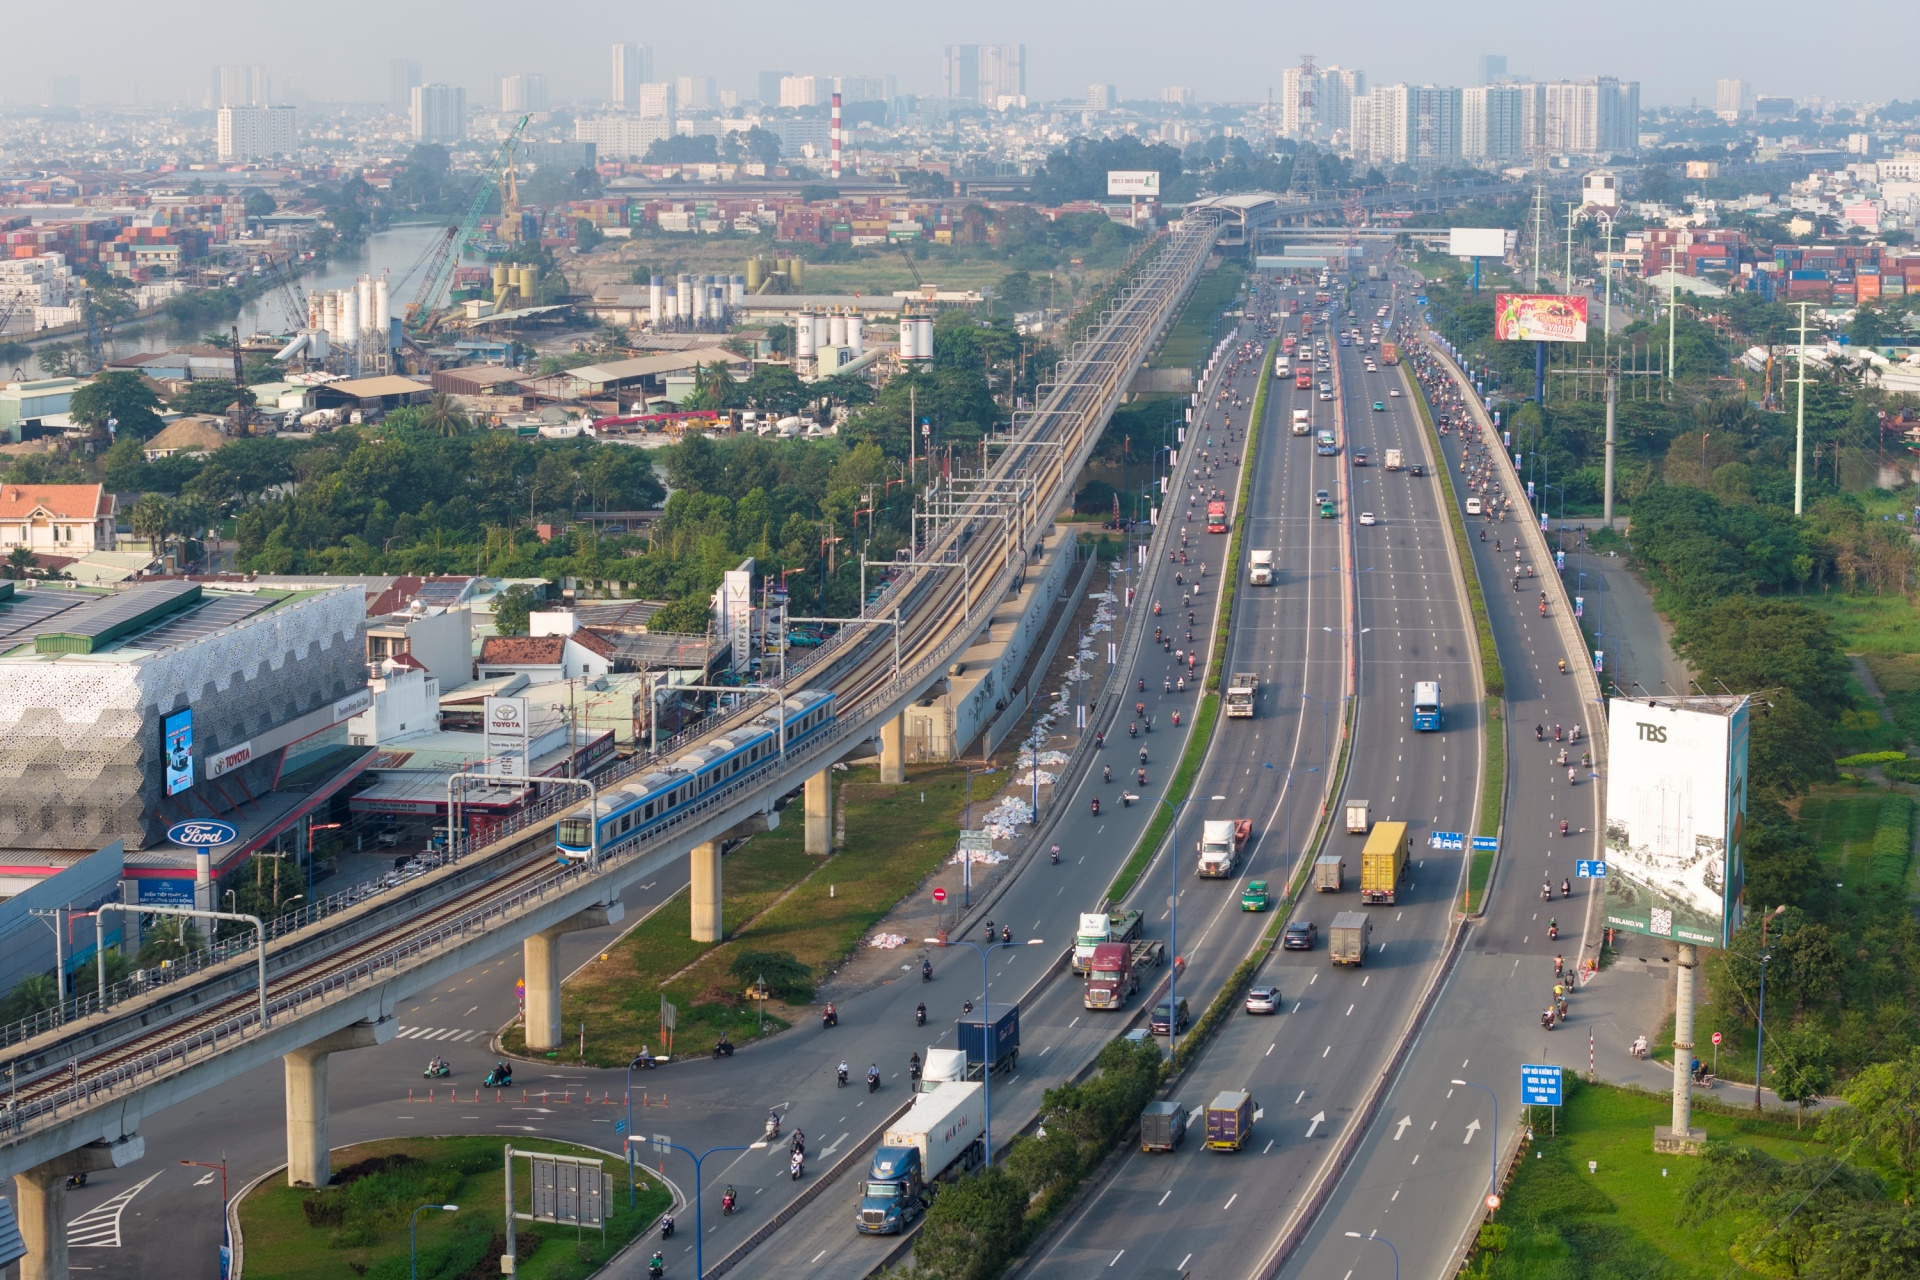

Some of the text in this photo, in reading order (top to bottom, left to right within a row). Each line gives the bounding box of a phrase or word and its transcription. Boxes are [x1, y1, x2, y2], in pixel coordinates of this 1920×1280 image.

[1636, 722, 1667, 743] TBS
[225, 748, 250, 768] TOYOTA
[181, 825, 222, 842] Ford
[1608, 916, 1644, 928] TBSLAND.VN
